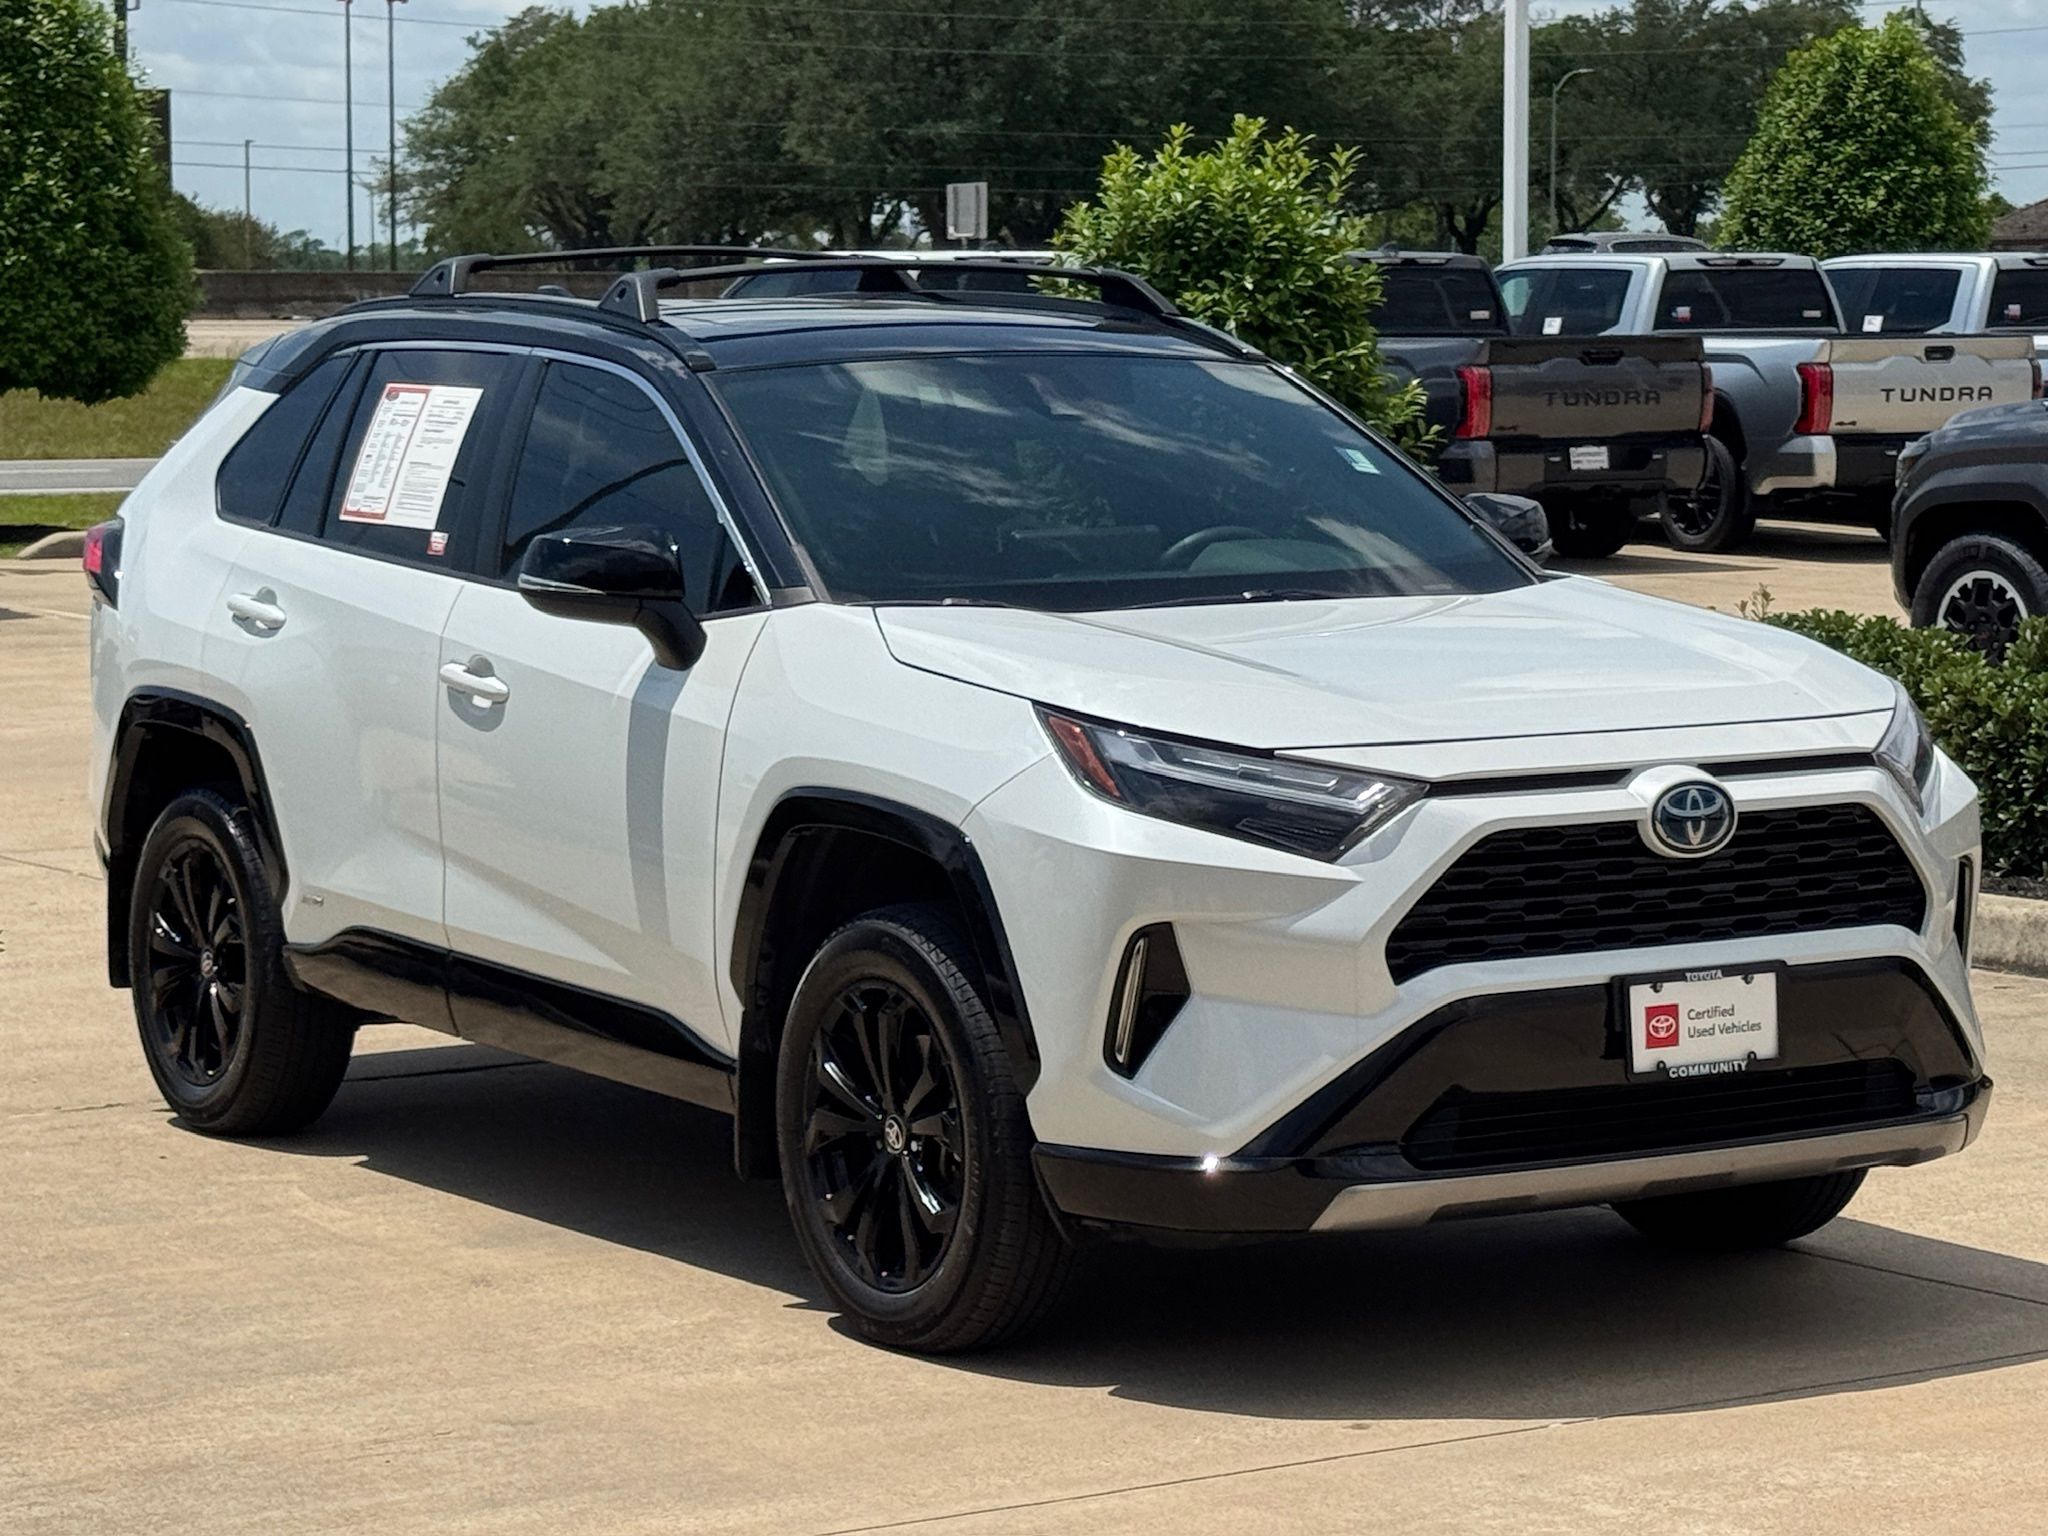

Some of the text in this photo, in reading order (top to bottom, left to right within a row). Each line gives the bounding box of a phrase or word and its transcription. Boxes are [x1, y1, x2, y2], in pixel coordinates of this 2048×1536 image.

[1544, 389, 1661, 407] TUNDRA
[1880, 386, 1993, 403] TUNDRA
[1685, 970, 1723, 983] TOYOTA
[1687, 1004, 1735, 1021] Certified
[1688, 1021, 1762, 1039] Used Vehicles
[1669, 1060, 1748, 1078] COMMUNITY
